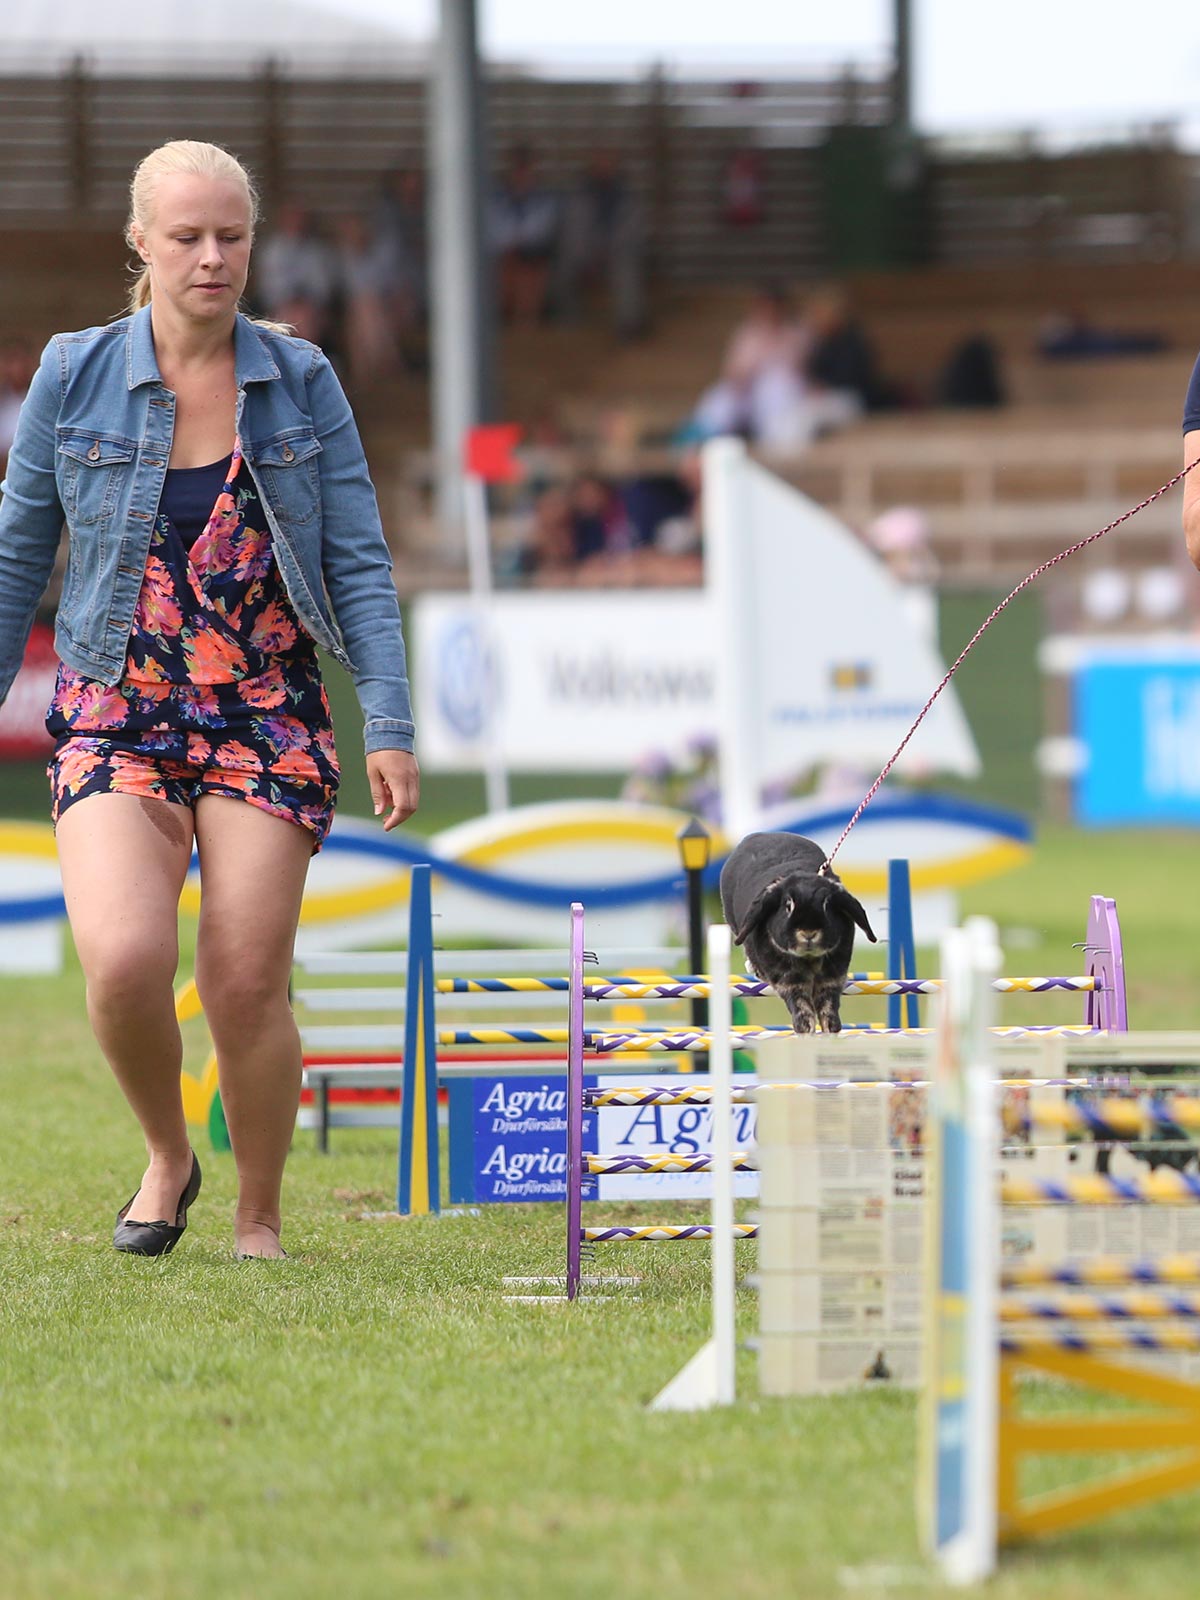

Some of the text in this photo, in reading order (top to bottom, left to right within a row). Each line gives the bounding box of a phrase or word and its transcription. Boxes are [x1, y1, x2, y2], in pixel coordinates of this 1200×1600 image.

[480, 1083, 567, 1119] Agria
[616, 1105, 758, 1153] Agi
[481, 1145, 567, 1180] Agria
